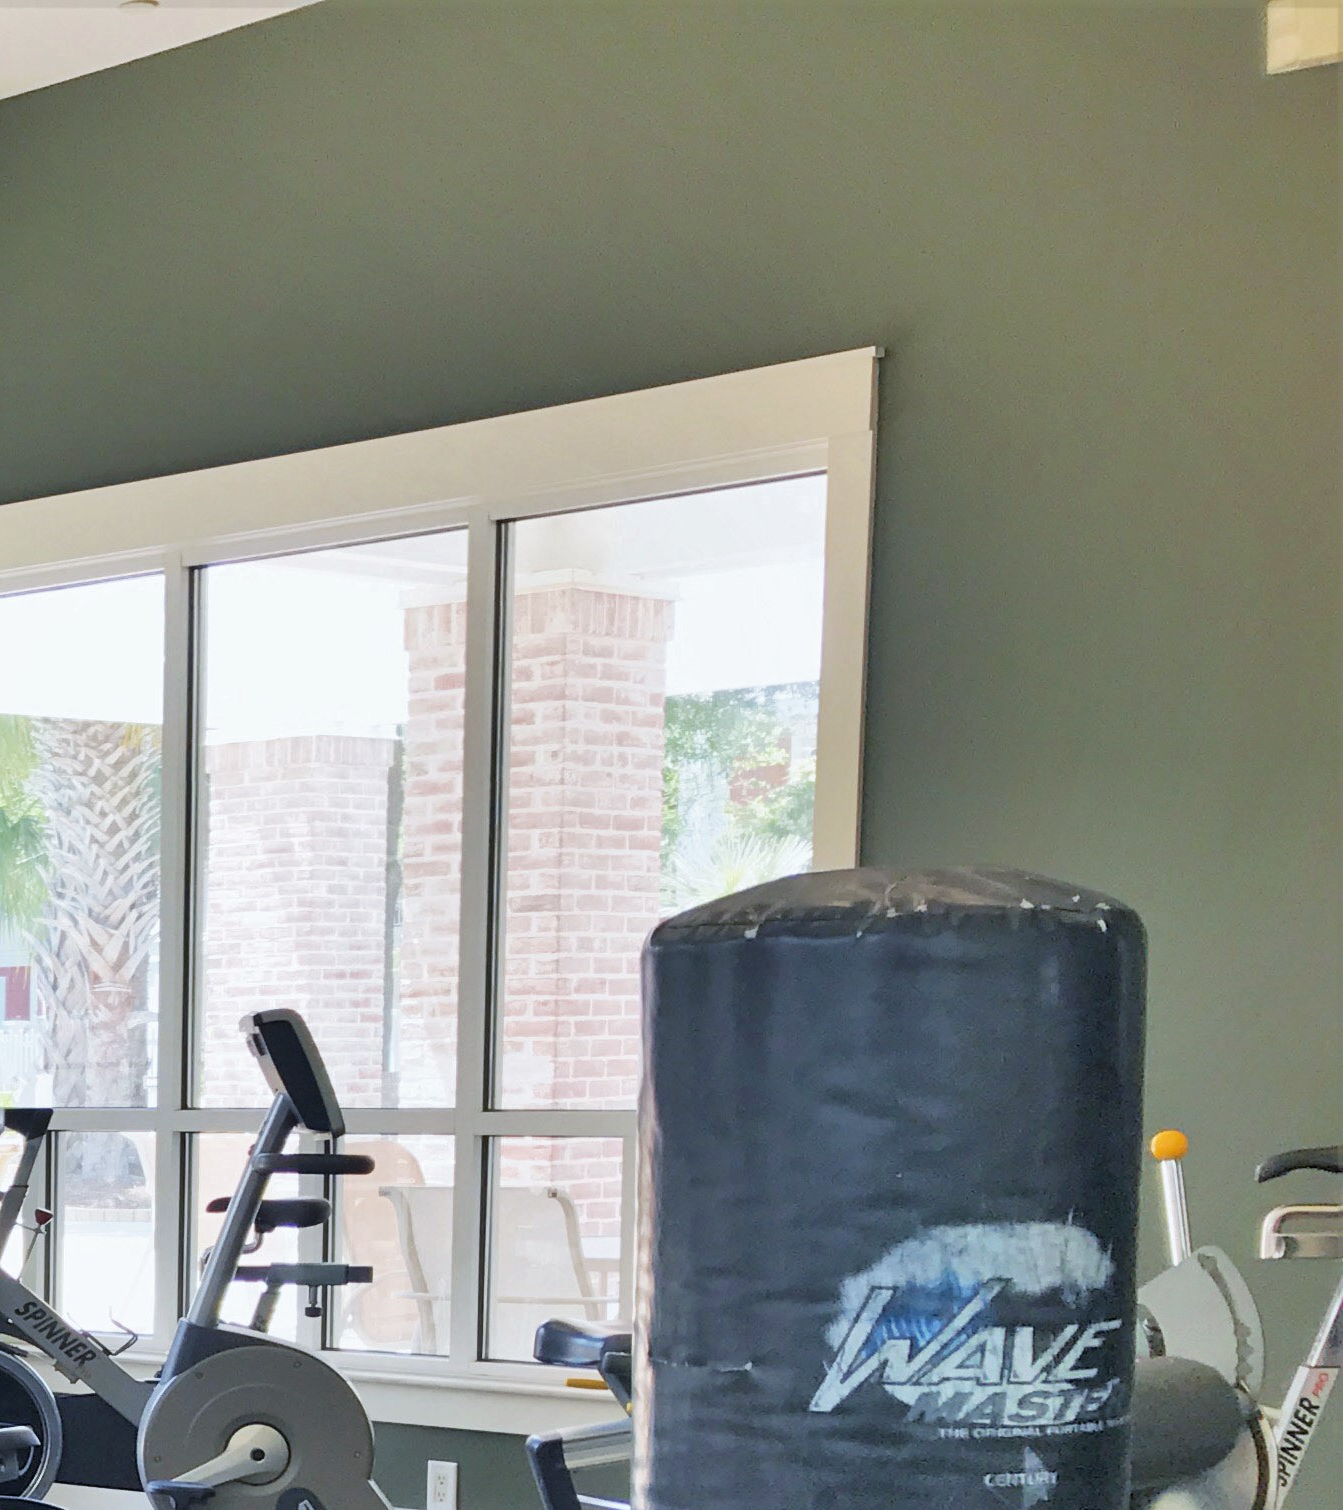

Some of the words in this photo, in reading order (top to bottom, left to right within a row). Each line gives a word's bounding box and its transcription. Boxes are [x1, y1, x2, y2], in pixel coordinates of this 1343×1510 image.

[14, 1301, 97, 1367] SPINNER
[808, 1278, 1123, 1414] WAVE
[1312, 1372, 1330, 1398] PRO
[938, 1427, 969, 1439] THE
[982, 1470, 1059, 1488] CENTURY
